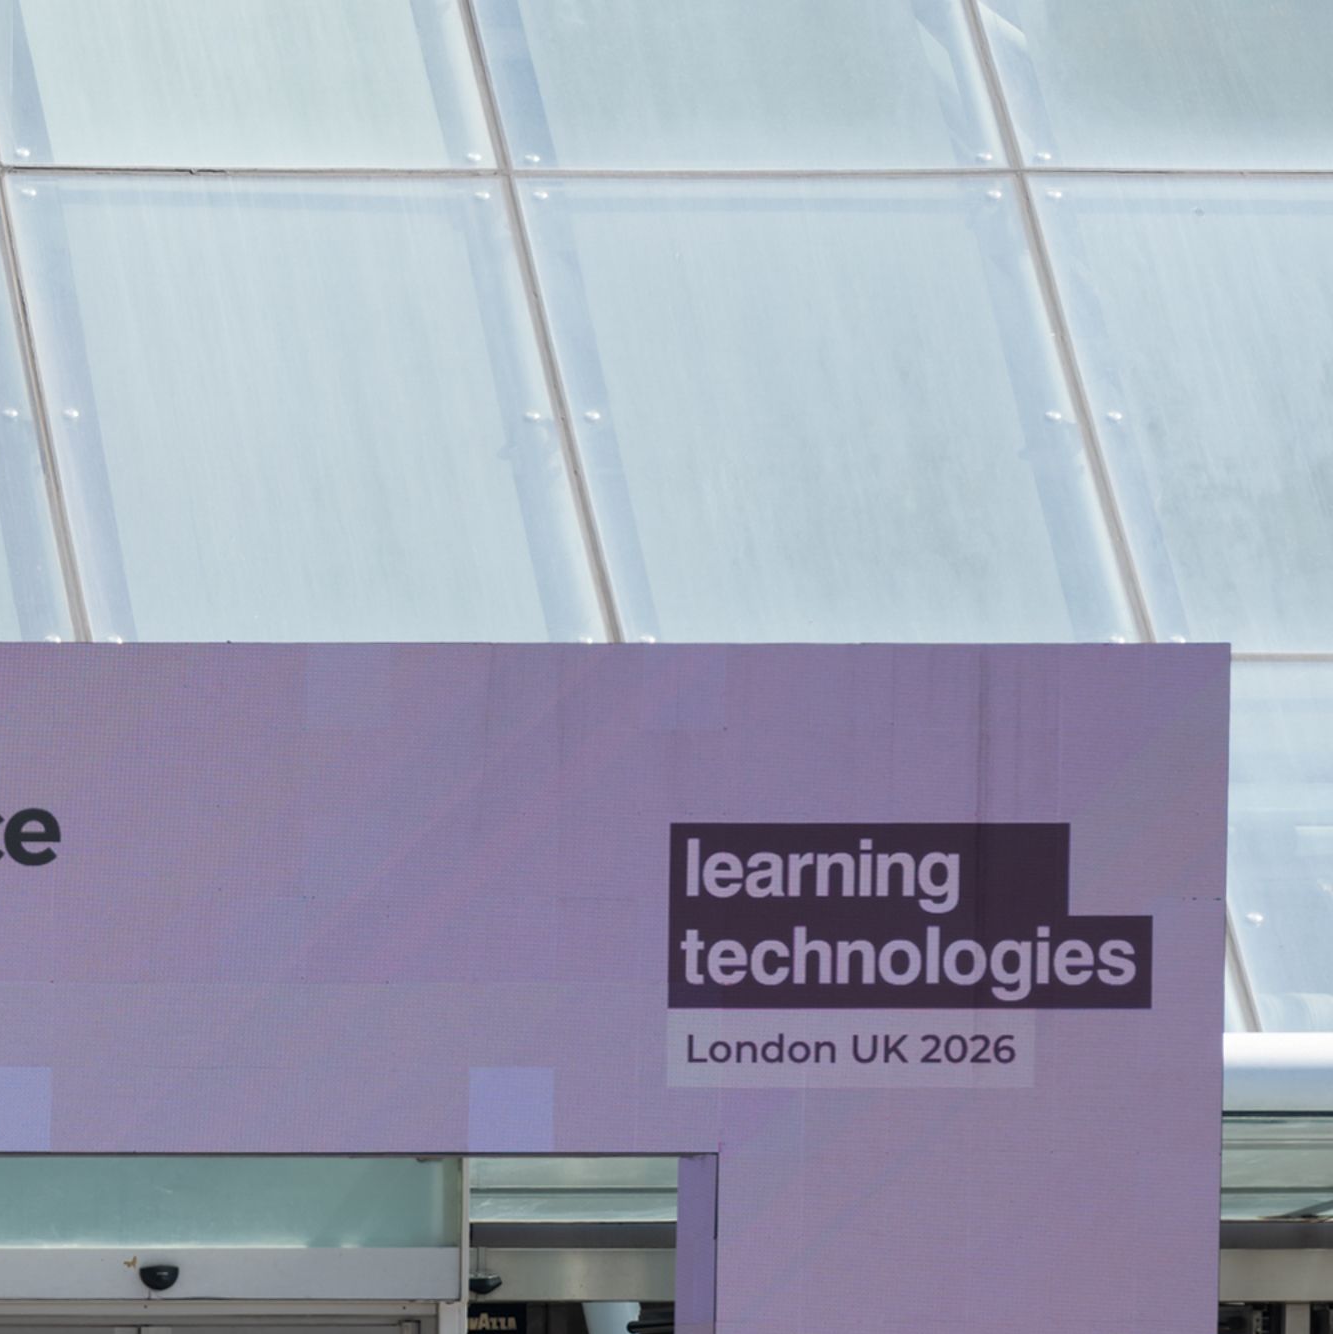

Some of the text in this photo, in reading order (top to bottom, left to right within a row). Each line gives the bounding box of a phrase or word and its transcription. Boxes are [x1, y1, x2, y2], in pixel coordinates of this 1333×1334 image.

[685, 838, 961, 914] learning
[681, 925, 1137, 1002] technologies
[687, 1032, 1017, 1065] London UK 2026
